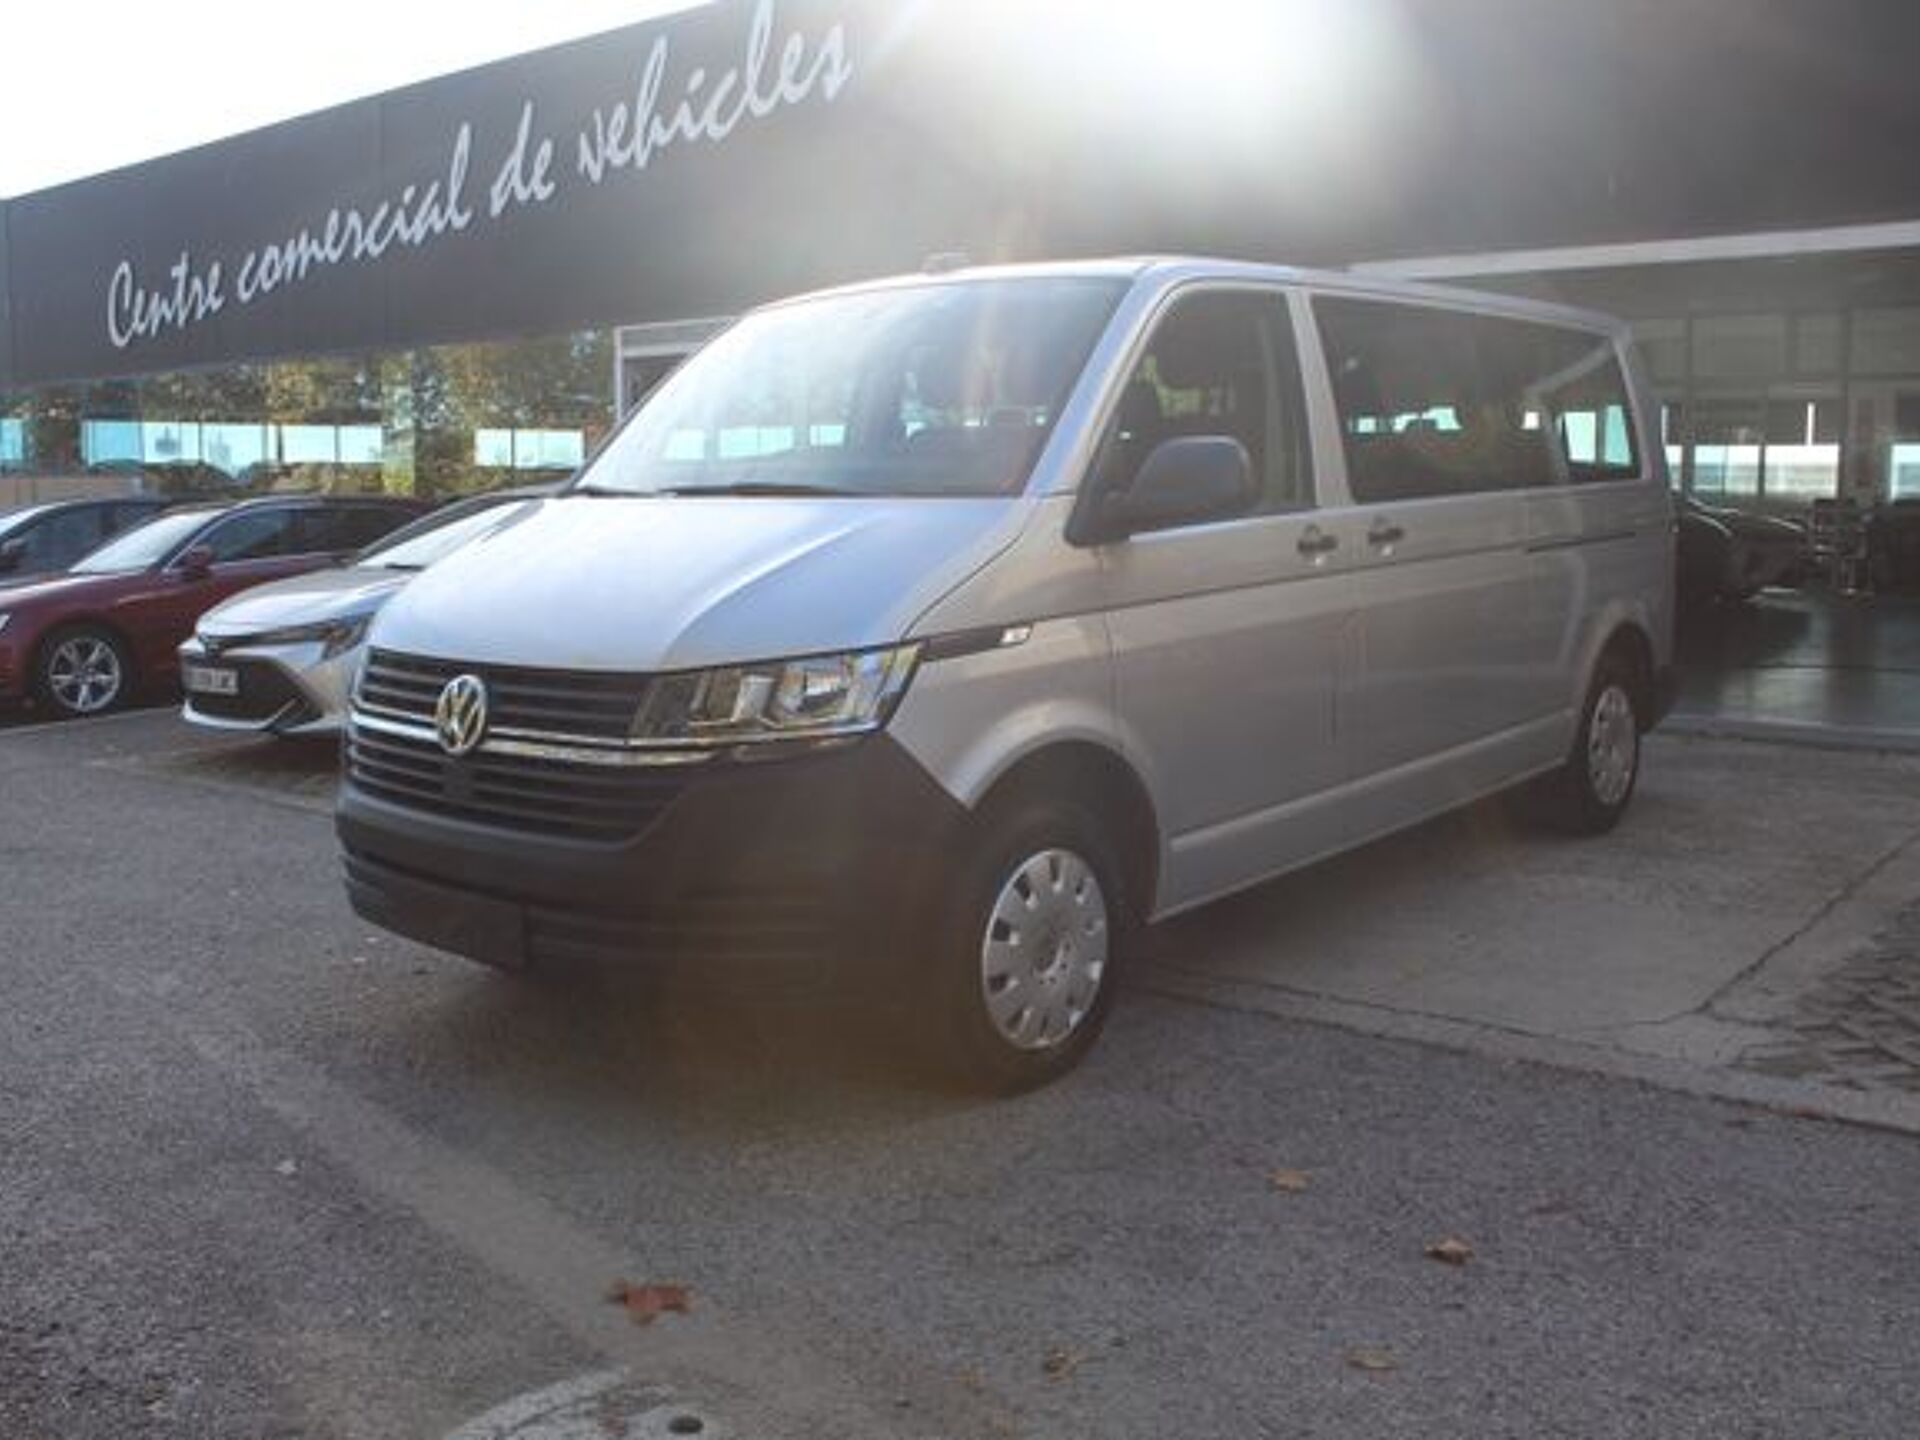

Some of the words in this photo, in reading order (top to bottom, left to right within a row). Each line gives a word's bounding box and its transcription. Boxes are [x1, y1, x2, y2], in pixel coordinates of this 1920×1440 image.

[107, 251, 224, 348] Centre
[236, 122, 473, 302] comercial
[489, 100, 555, 217] de
[577, 0, 854, 183] vehicles
